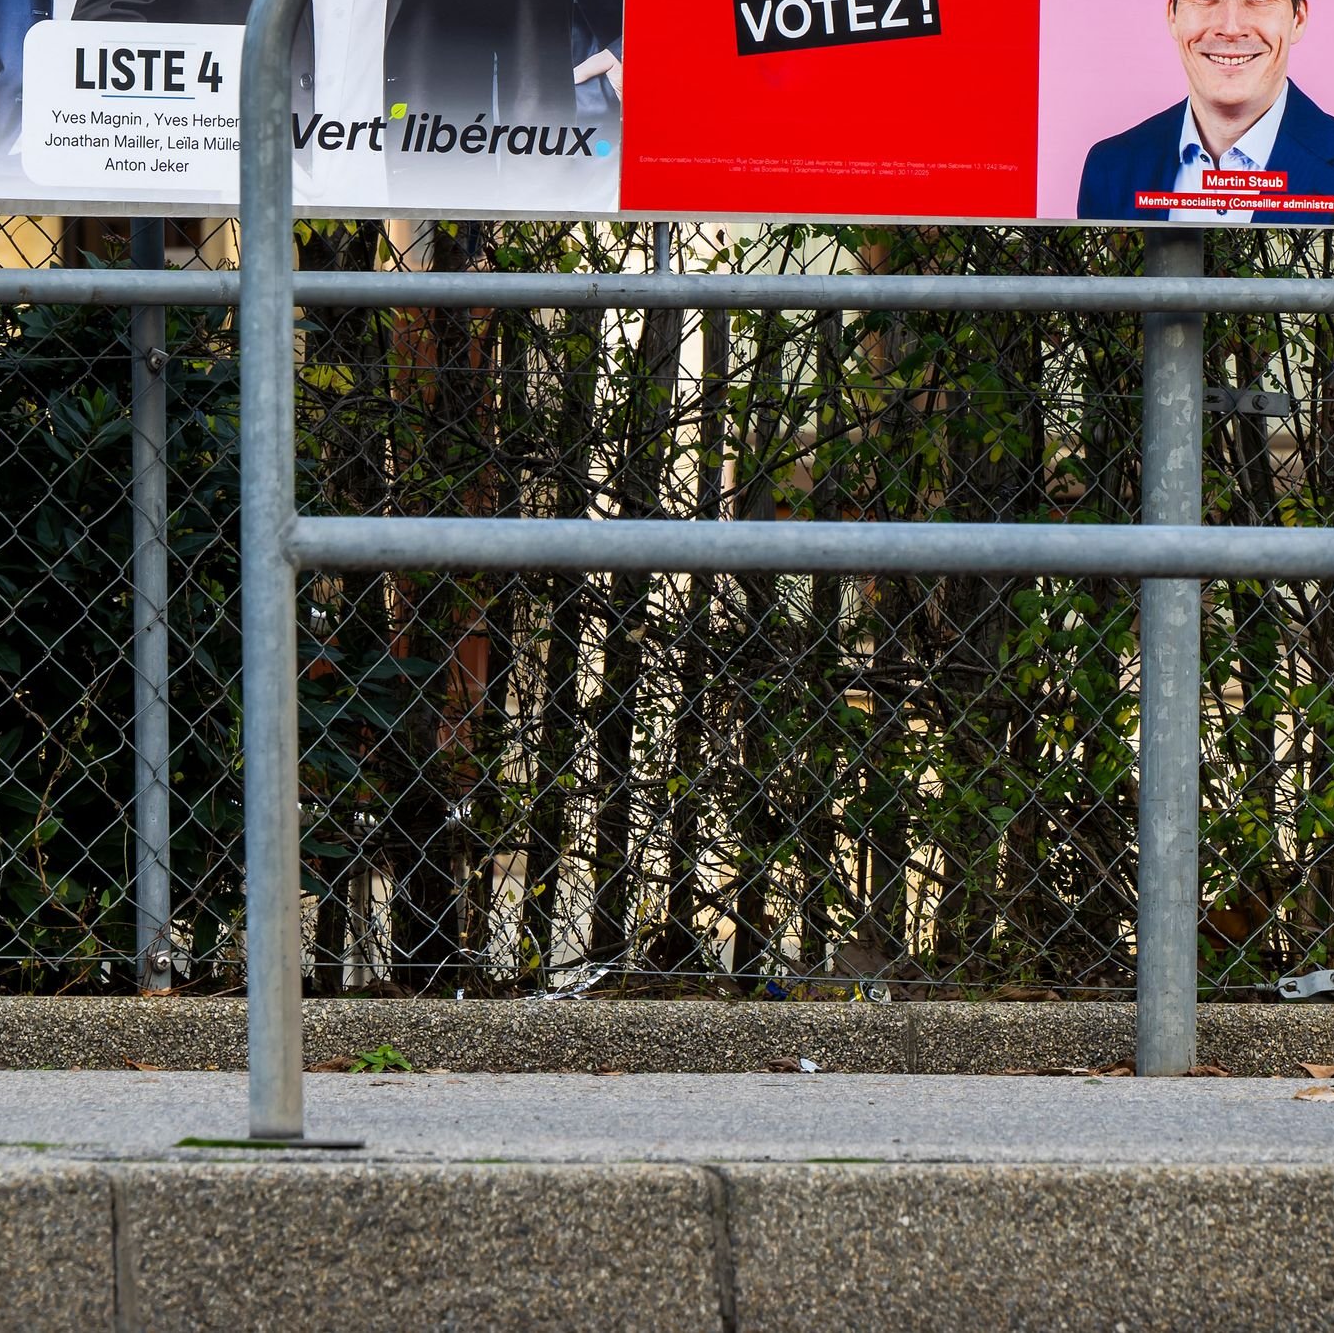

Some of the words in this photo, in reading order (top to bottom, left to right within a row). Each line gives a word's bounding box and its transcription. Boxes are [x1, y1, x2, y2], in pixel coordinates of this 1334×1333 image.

[74, 48, 187, 93] LISTE
[198, 50, 222, 92] 4
[52, 110, 86, 124] Yves
[91, 111, 142, 128] Magnin
[154, 113, 188, 126] Yves
[45, 133, 110, 147] Jonathan
[114, 135, 163, 151] Mailler,
[168, 136, 199, 150] Leïla
[105, 158, 146, 171] Anton
[151, 159, 189, 173] Jeker
[1207, 175, 1246, 187] Martin
[1249, 176, 1283, 188] Staub
[1139, 196, 1178, 207] Membre
[1181, 197, 1226, 208] socialiste
[1229, 198, 1281, 210] (Conseiller
